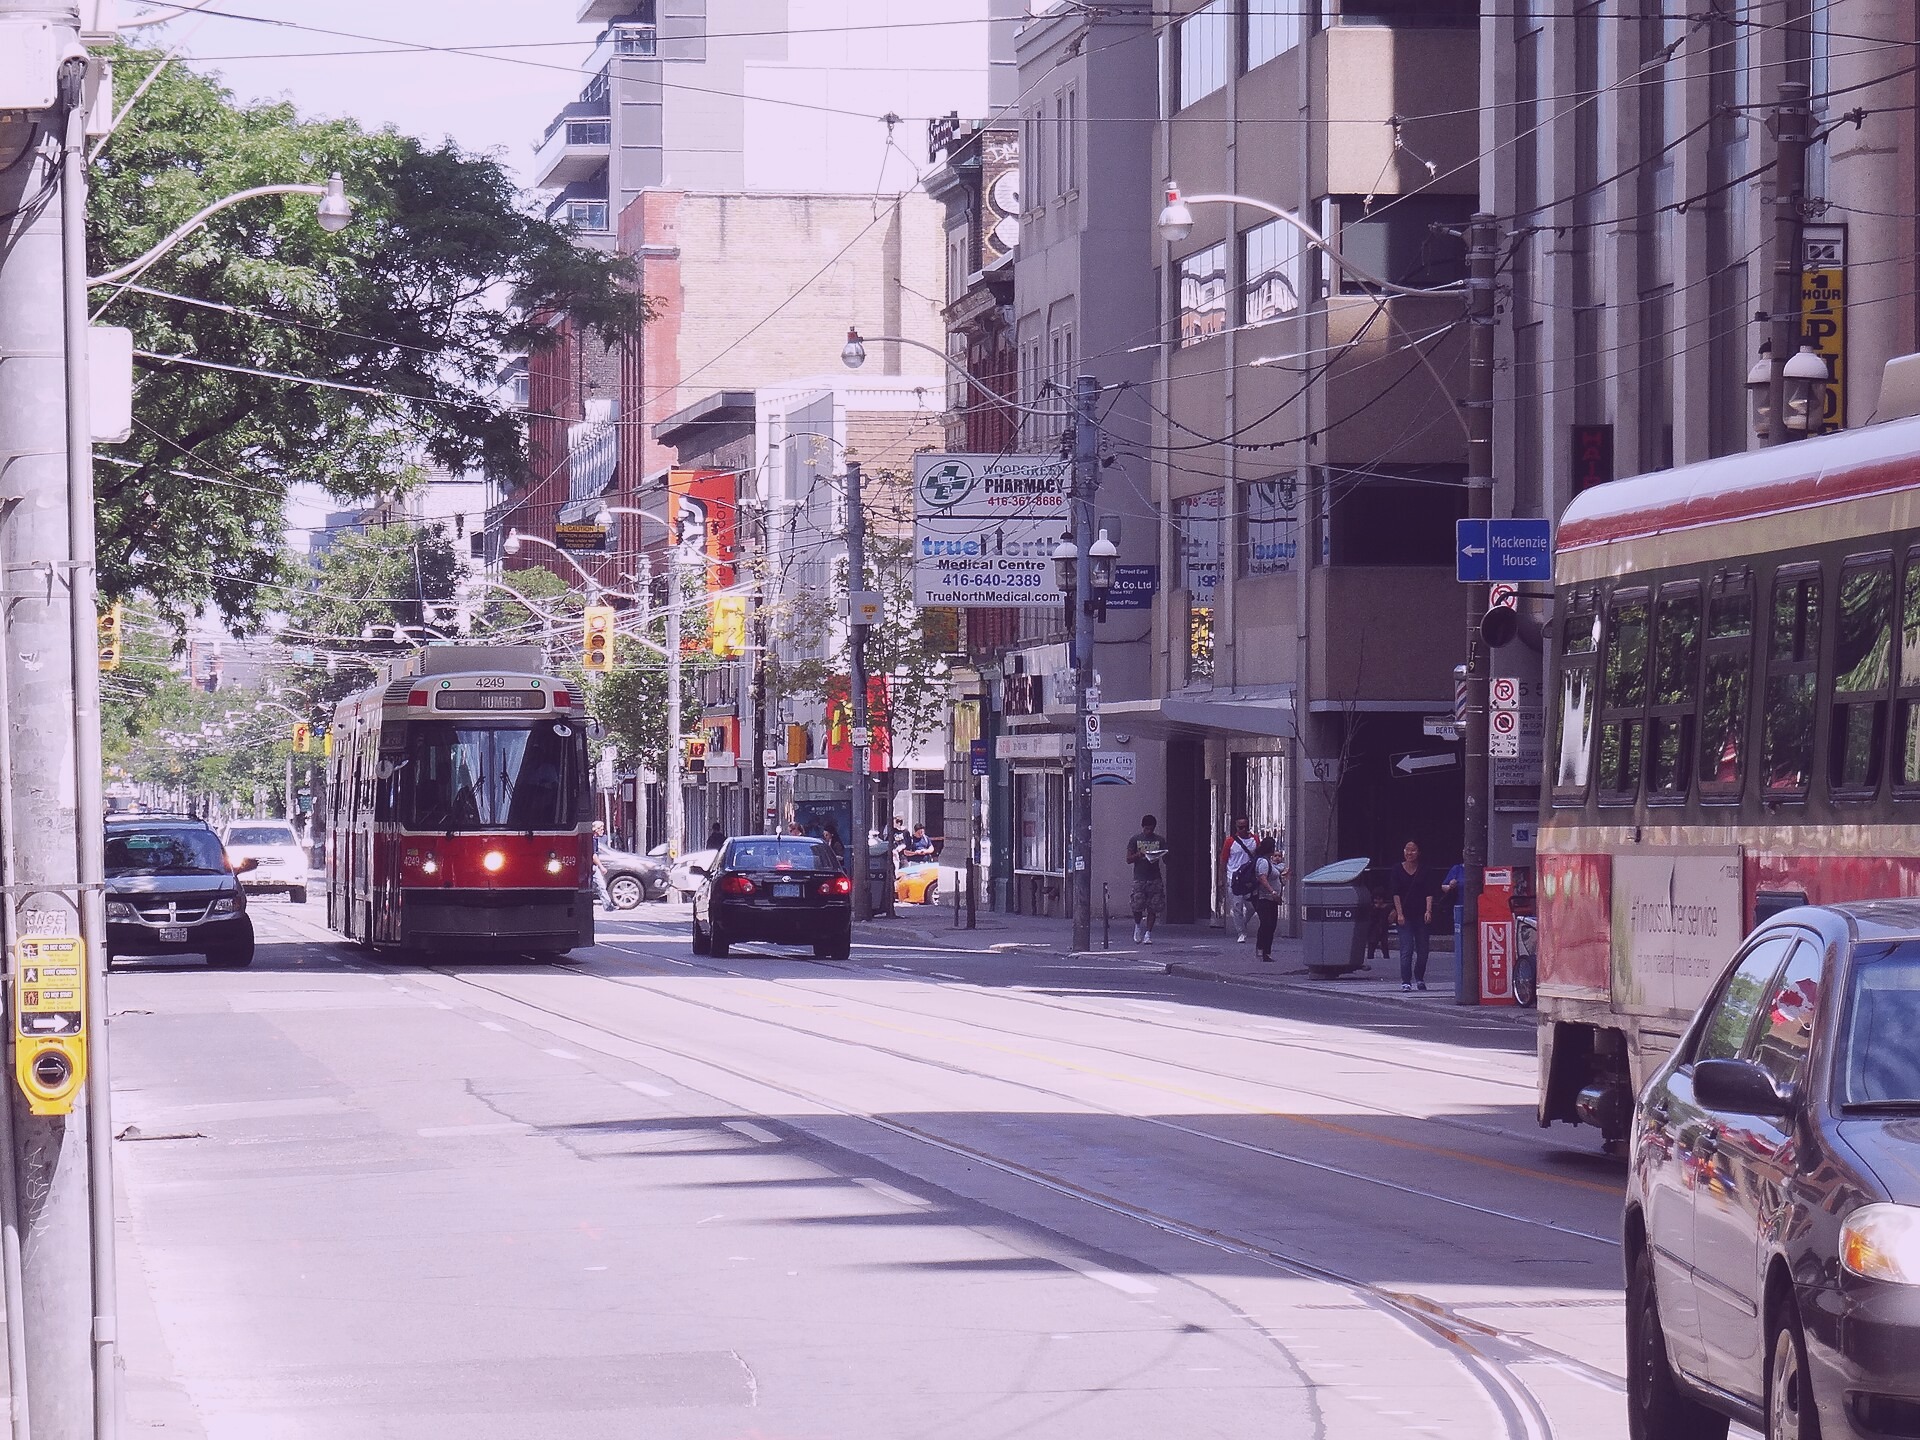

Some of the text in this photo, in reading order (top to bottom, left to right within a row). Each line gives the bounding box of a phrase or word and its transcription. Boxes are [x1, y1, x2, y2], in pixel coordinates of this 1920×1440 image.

[1802, 289, 1841, 300] HOUR
[983, 465, 1067, 476] WOODGREEN
[984, 478, 1065, 494] PHARMACY
[987, 496, 1063, 506] 416-367-8686
[1491, 535, 1547, 551] Mackenzie
[938, 559, 1046, 570] Medical Centre
[1502, 554, 1537, 567] House
[942, 574, 1041, 586] 416-640-2389
[926, 591, 1060, 602] TrueNorthMedical.com
[475, 678, 505, 688] 4249
[480, 696, 522, 709] HUMBER
[1115, 756, 1133, 766] City
[403, 856, 420, 866] 4249
[1325, 909, 1343, 919] Litter
